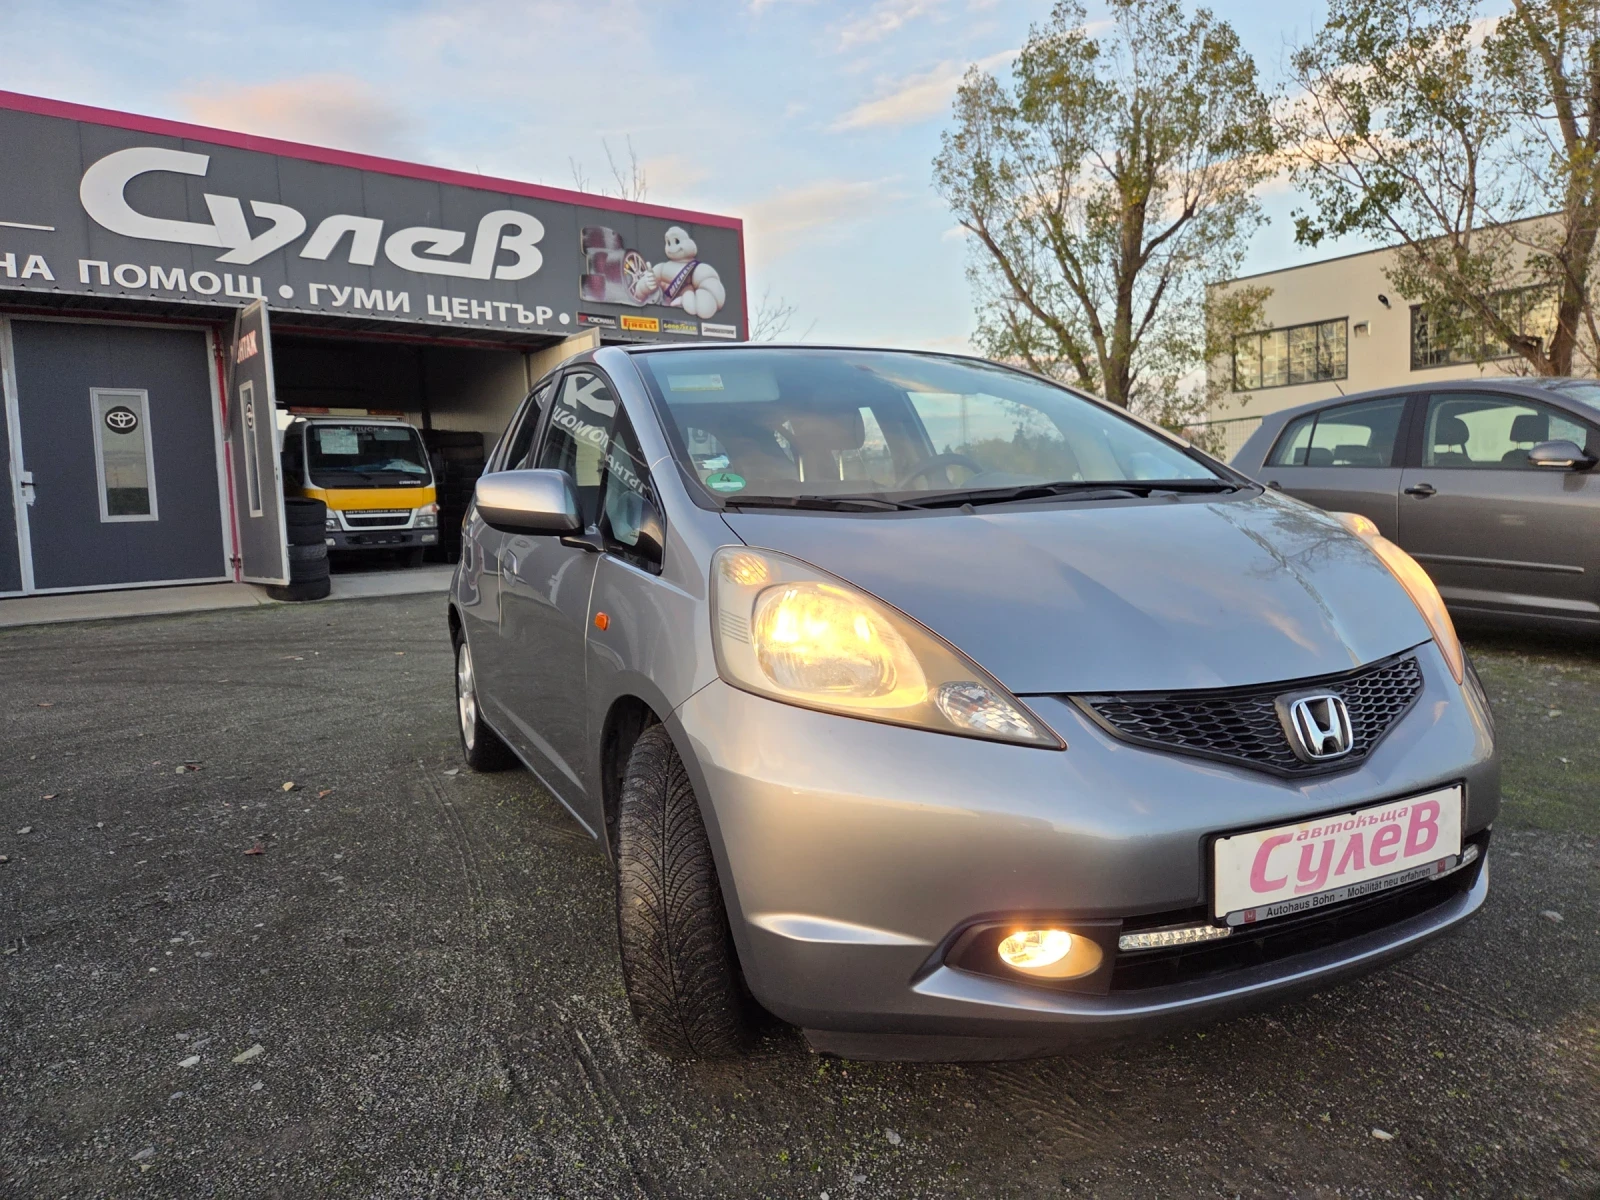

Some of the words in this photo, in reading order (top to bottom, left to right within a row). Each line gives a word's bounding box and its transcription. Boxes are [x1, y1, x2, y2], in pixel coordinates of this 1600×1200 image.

[78, 259, 268, 302] ПОМОЩ
[308, 283, 410, 313] ГУМИ
[427, 294, 553, 325] ЦЕНТЪР
[623, 317, 657, 330] PIRELLI
[1297, 807, 1408, 841] автокъща
[1266, 900, 1310, 917] Autohaus
[1312, 893, 1335, 907] Bohn
[1347, 882, 1382, 898] Mobilität
[1384, 878, 1398, 888] neu
[1400, 867, 1431, 883] erfahren
